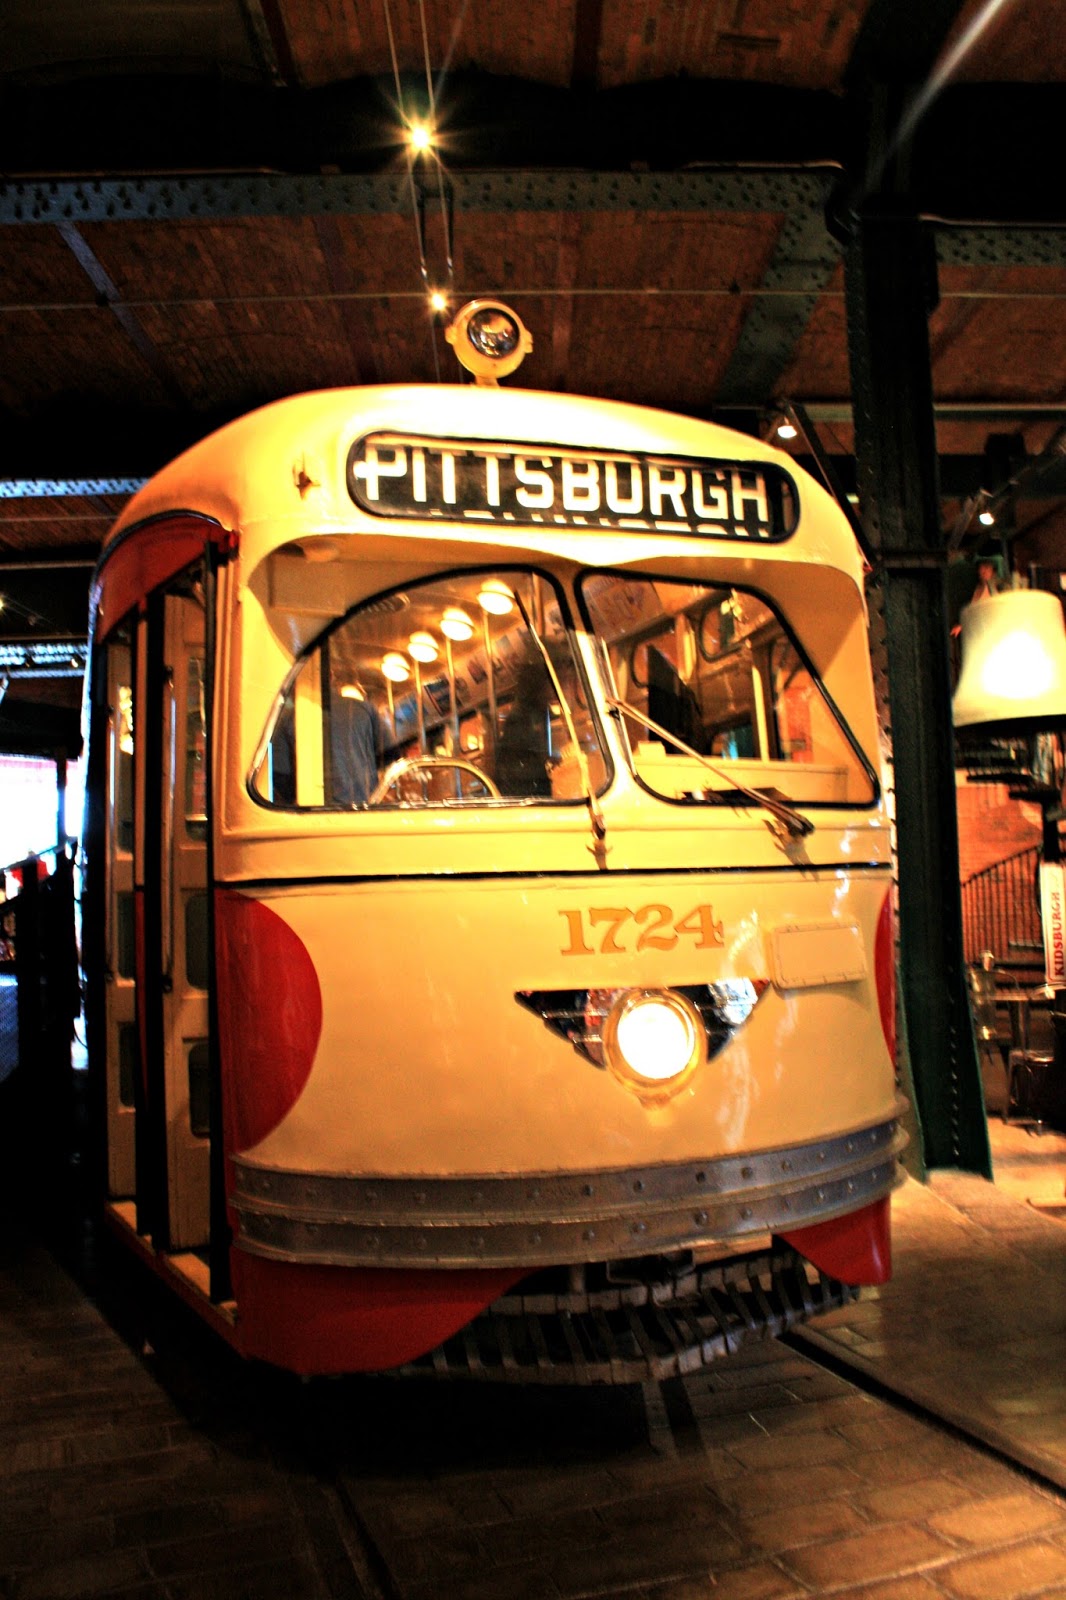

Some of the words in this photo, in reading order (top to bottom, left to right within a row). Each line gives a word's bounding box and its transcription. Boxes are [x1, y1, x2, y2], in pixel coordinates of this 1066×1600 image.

[358, 443, 769, 523] PITTSBURGH
[558, 904, 724, 956] 1724
[1052, 892, 1065, 976] KIDSBURGH
